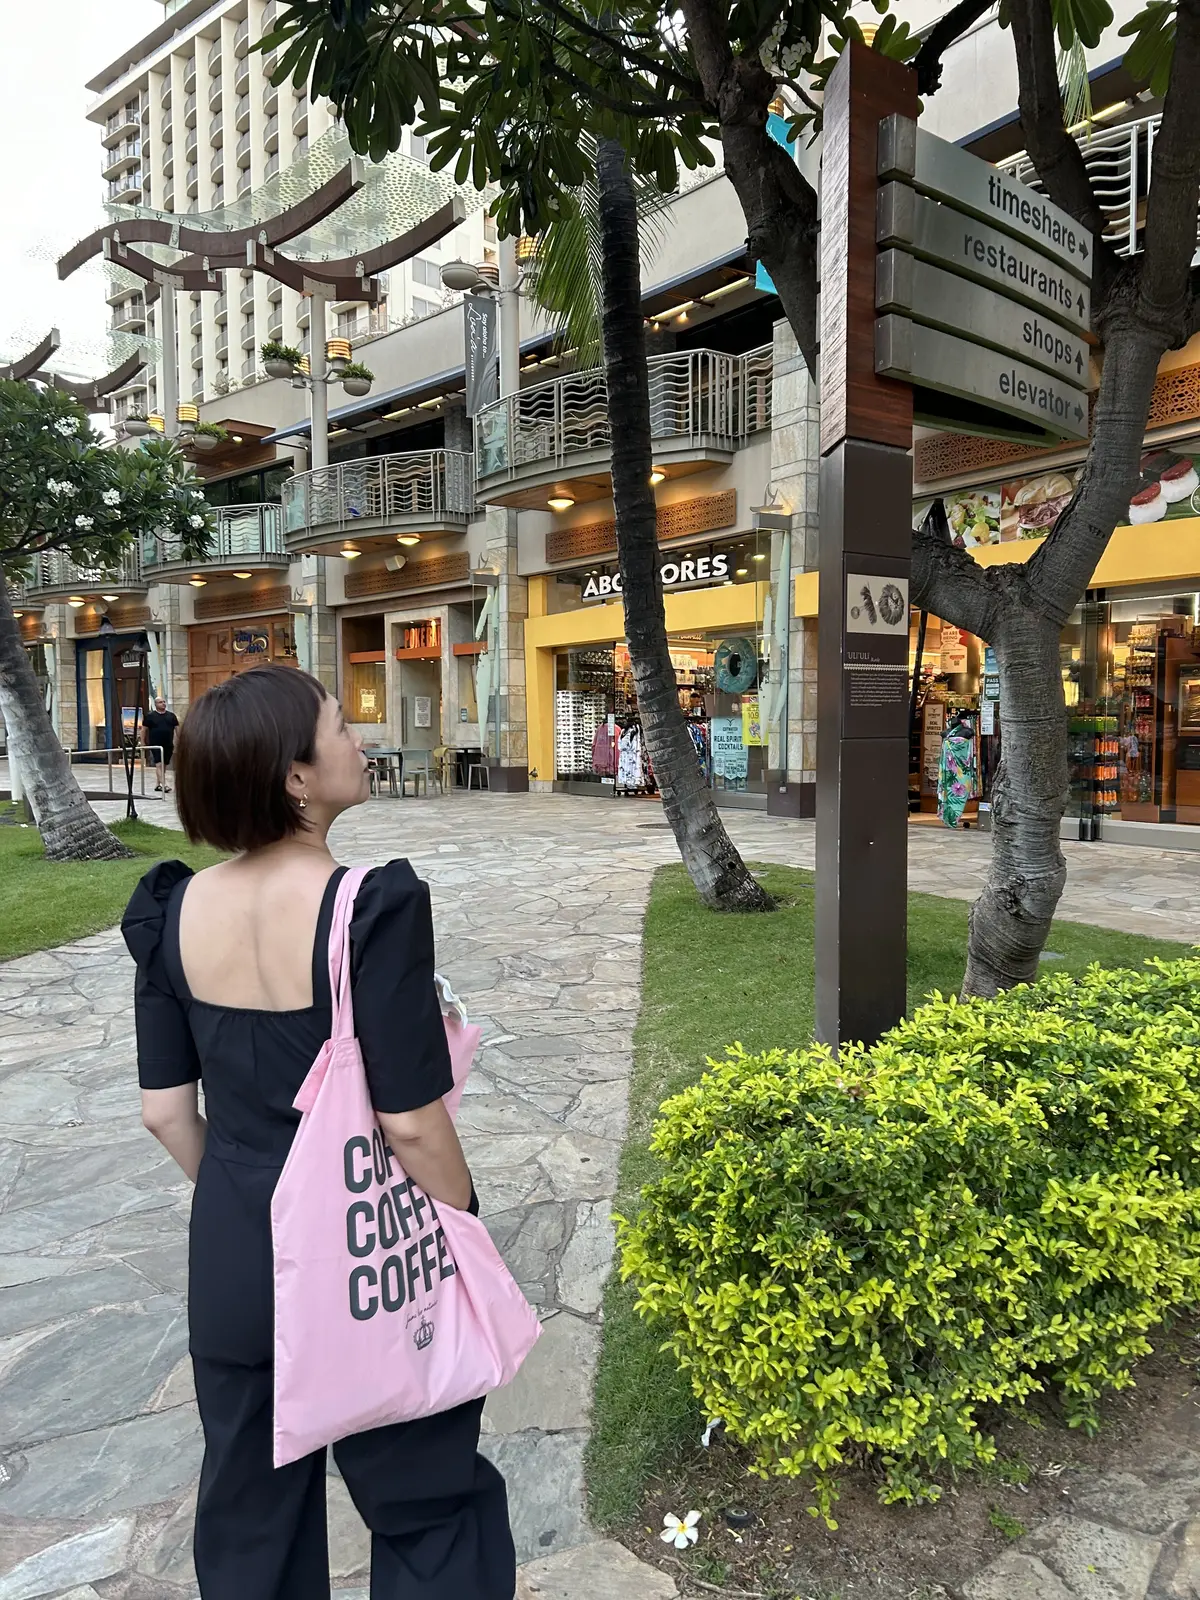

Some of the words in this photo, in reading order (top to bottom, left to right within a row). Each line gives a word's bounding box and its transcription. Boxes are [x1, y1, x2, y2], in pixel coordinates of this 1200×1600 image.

[988, 175, 1076, 253] timeshare
[964, 232, 1072, 309] restaurants
[1023, 320, 1072, 365] shops
[999, 370, 1071, 420] elevator
[583, 572, 623, 597] ABC
[660, 554, 728, 584] ORES
[346, 1177, 439, 1258] COFF
[349, 1225, 458, 1321] COFFE
